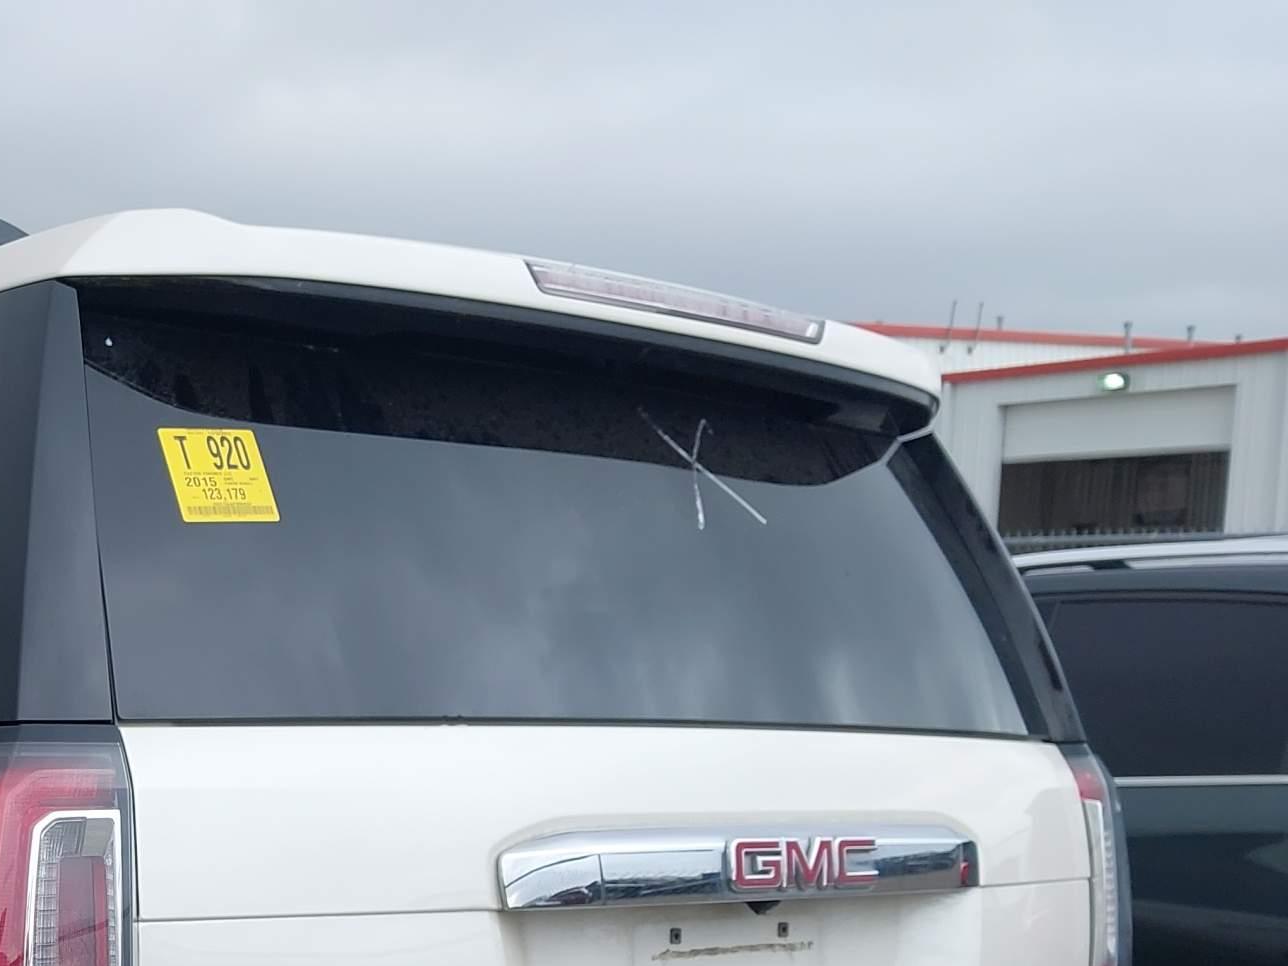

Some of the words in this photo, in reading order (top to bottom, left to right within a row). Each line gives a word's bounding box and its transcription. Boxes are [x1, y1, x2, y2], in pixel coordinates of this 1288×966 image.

[173, 435, 192, 470] T
[206, 435, 251, 471] 920
[184, 476, 218, 488] 2015
[202, 487, 247, 501] 123,179
[731, 836, 879, 889] GMC
